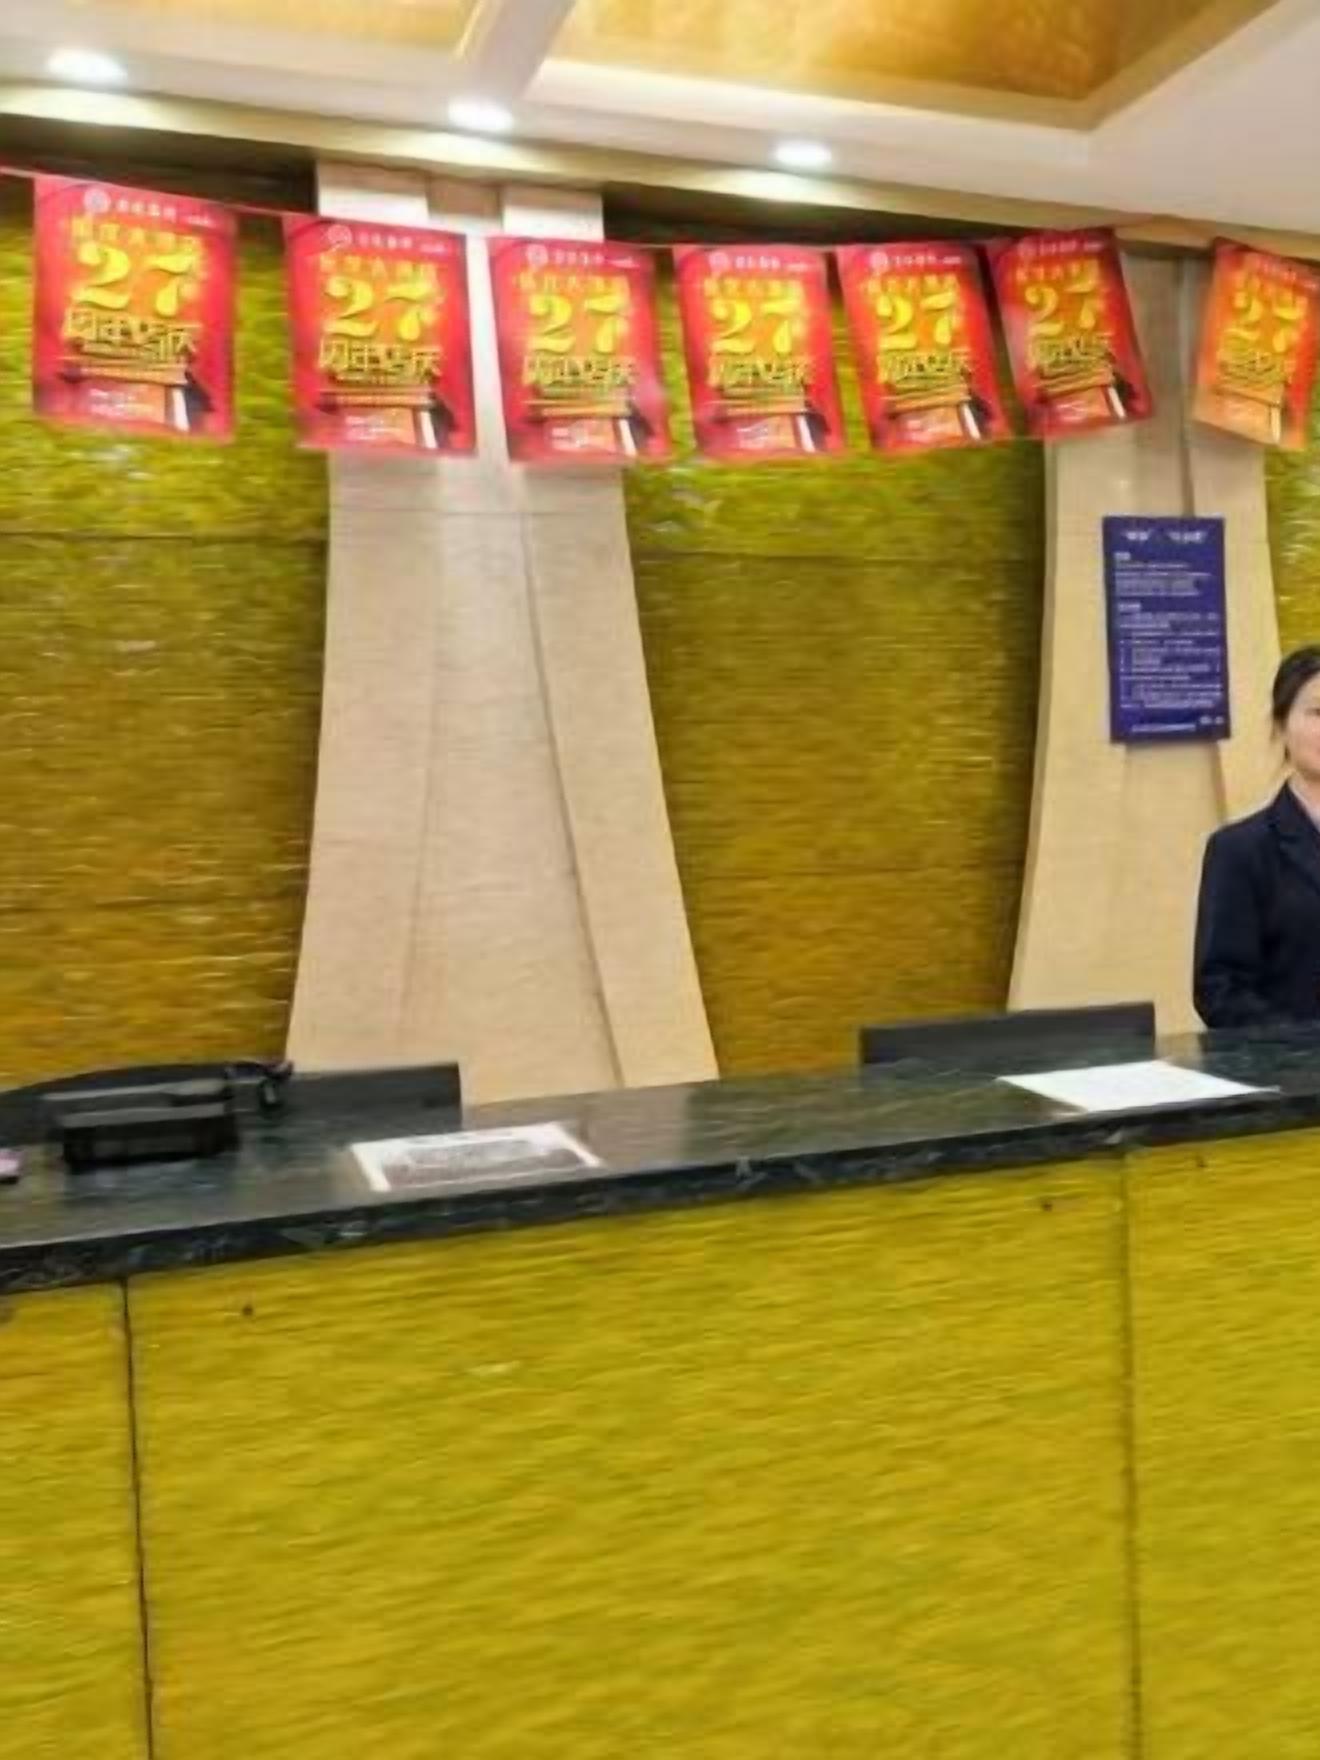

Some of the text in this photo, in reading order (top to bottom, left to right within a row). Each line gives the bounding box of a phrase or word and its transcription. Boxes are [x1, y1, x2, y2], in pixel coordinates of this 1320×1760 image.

[73, 241, 198, 317] 27
[324, 275, 437, 341] 27
[1025, 276, 1099, 336] 27
[528, 294, 631, 353] 27
[711, 299, 798, 353] 27
[876, 291, 958, 350] 27
